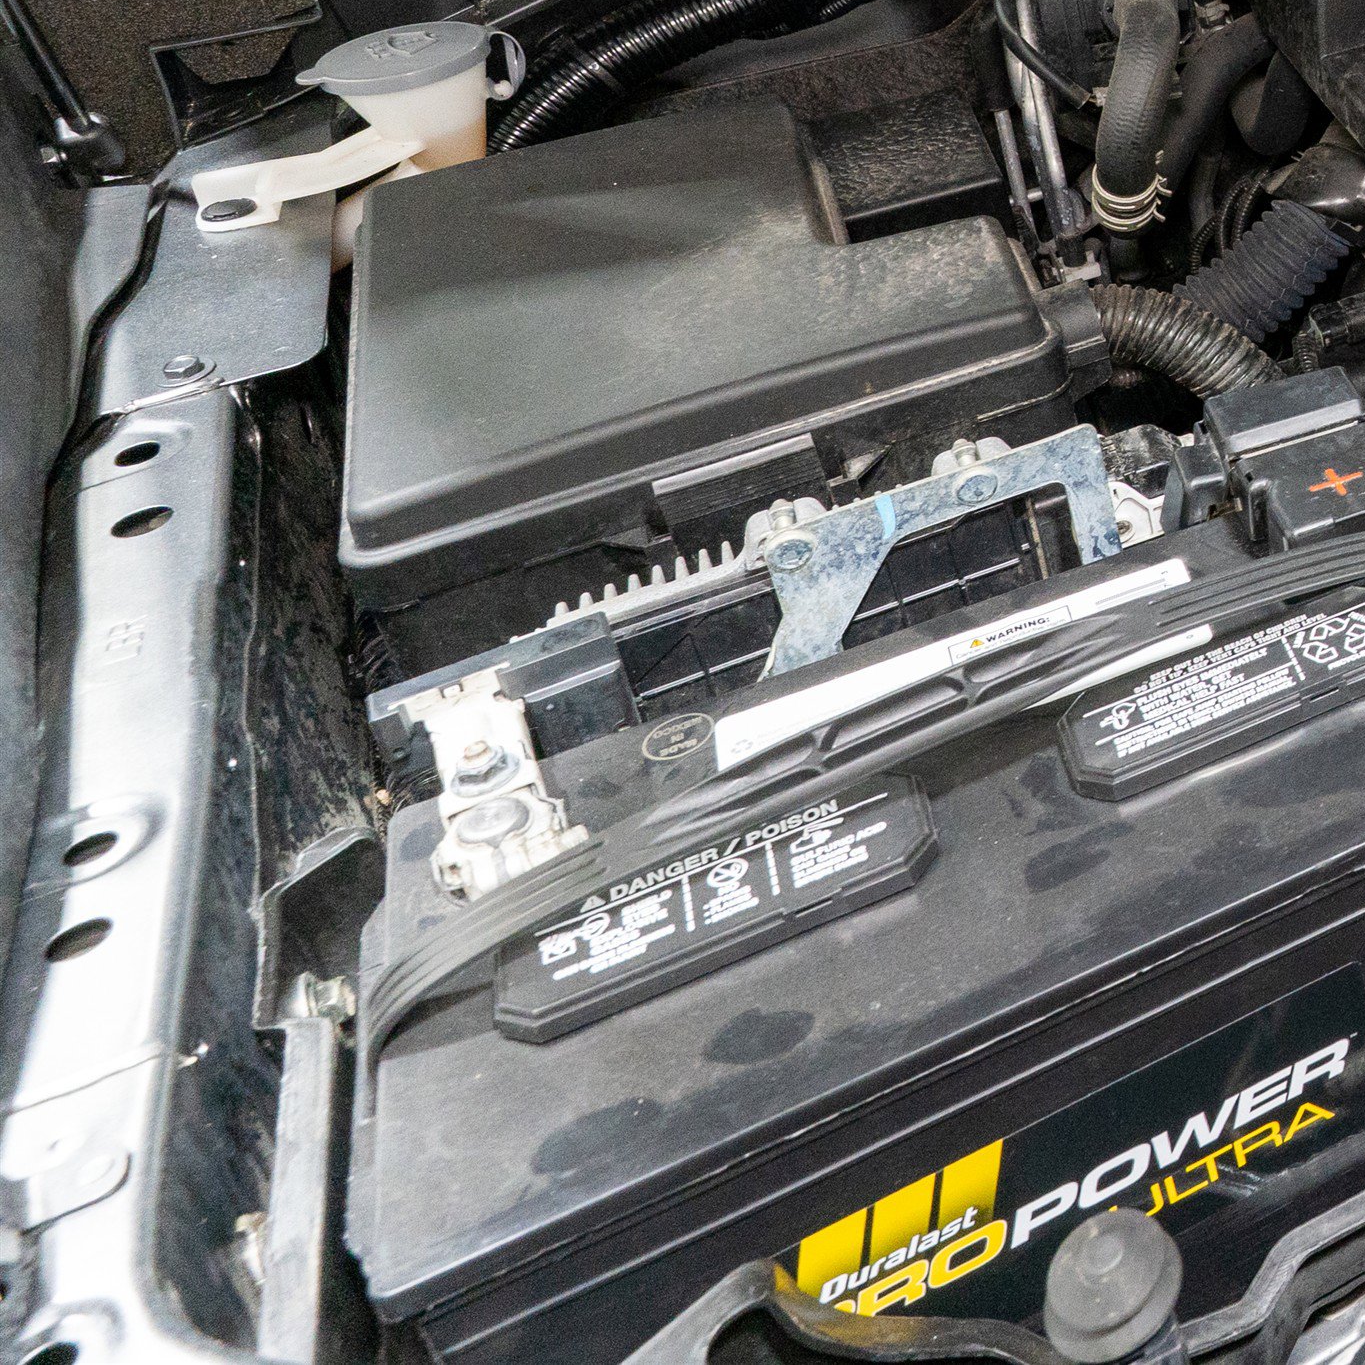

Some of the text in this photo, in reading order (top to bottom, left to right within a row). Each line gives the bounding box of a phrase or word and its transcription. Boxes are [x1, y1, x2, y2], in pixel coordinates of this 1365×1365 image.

[987, 618, 1049, 642] WARNING:
[1136, 687, 1171, 706] FLUSH
[1172, 676, 1199, 691] EYES
[1140, 697, 1168, 712] WITH
[1212, 671, 1231, 684] GET
[609, 847, 720, 902] DANGER
[745, 799, 839, 847] POISON
[818, 1206, 979, 1305] Duralast
